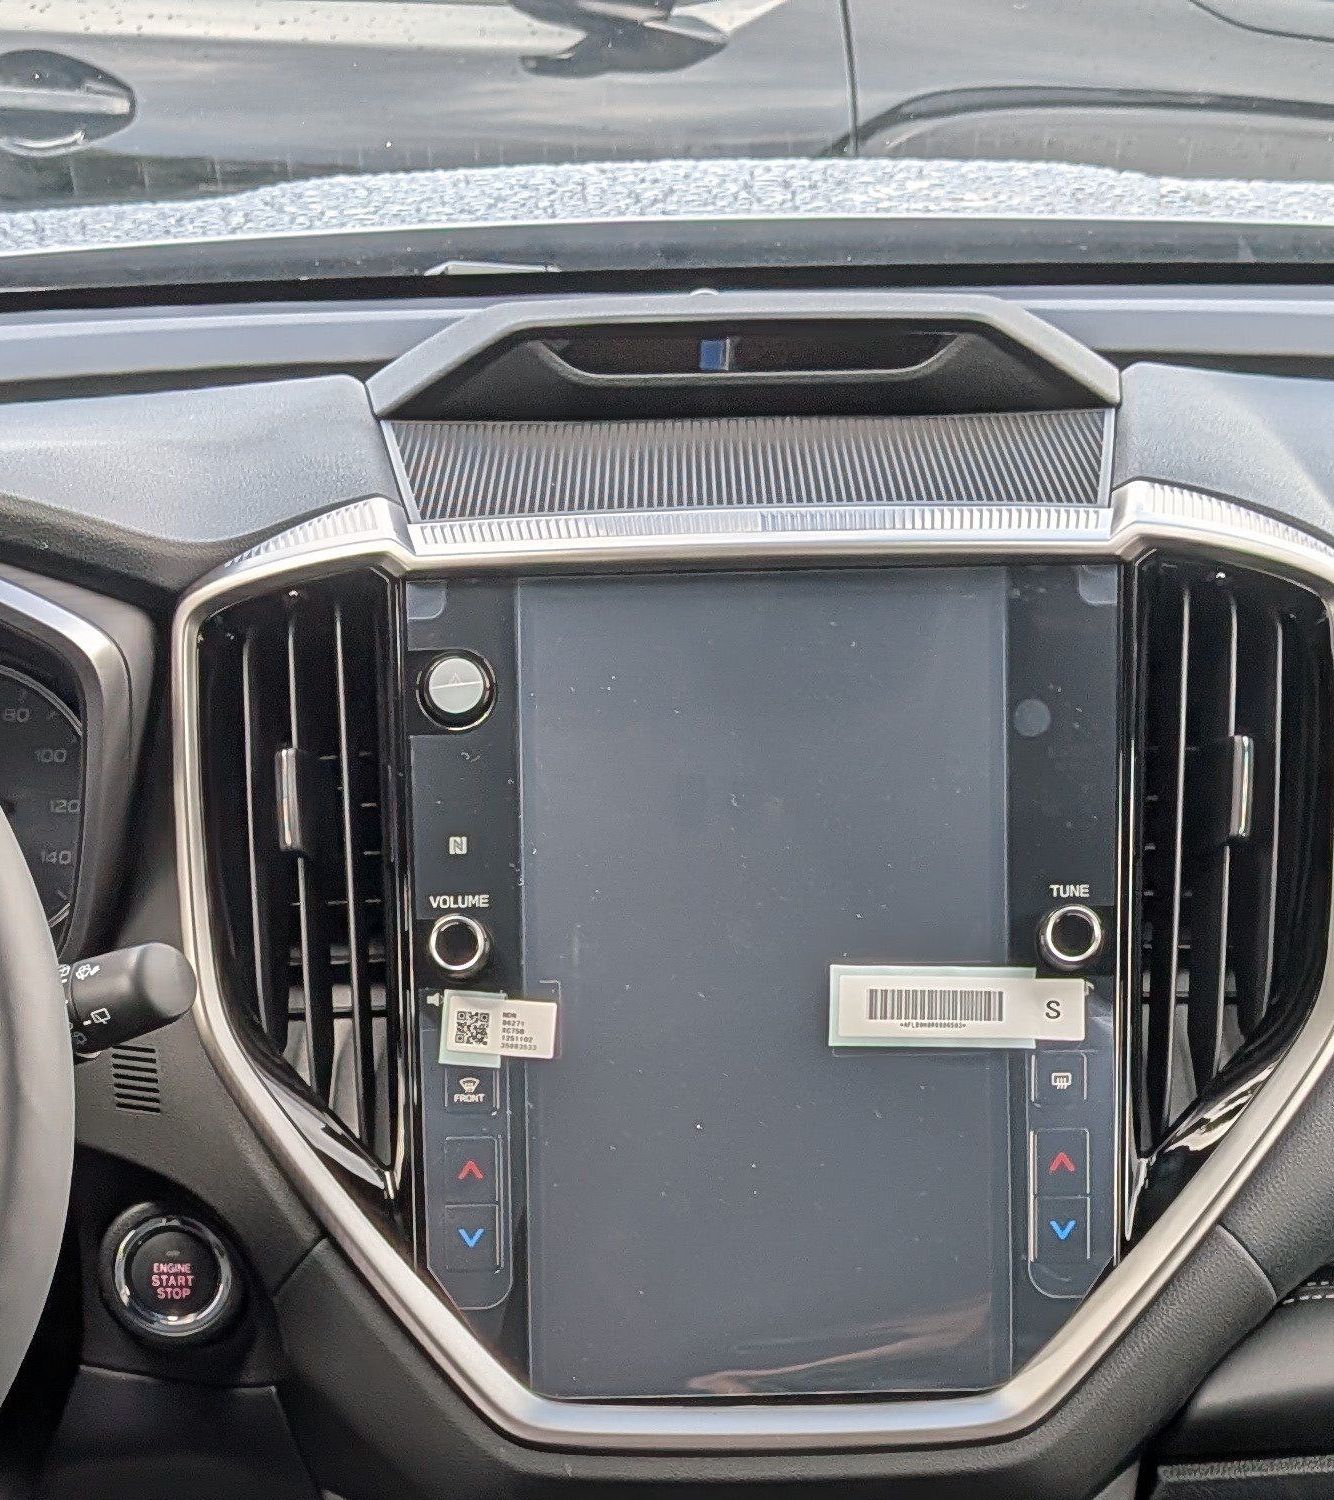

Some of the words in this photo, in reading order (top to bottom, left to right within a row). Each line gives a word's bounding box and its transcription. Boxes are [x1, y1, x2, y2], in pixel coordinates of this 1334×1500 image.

[36, 749, 67, 762] 100
[51, 800, 80, 813] 120
[42, 851, 71, 864] 140
[1049, 884, 1090, 898] TUNE
[429, 894, 490, 909] VOLUME
[1045, 1000, 1061, 1019] S
[454, 1093, 485, 1103] FRONT
[153, 1263, 192, 1274] ENGINE
[151, 1275, 195, 1286] START
[156, 1288, 191, 1299] STOP
